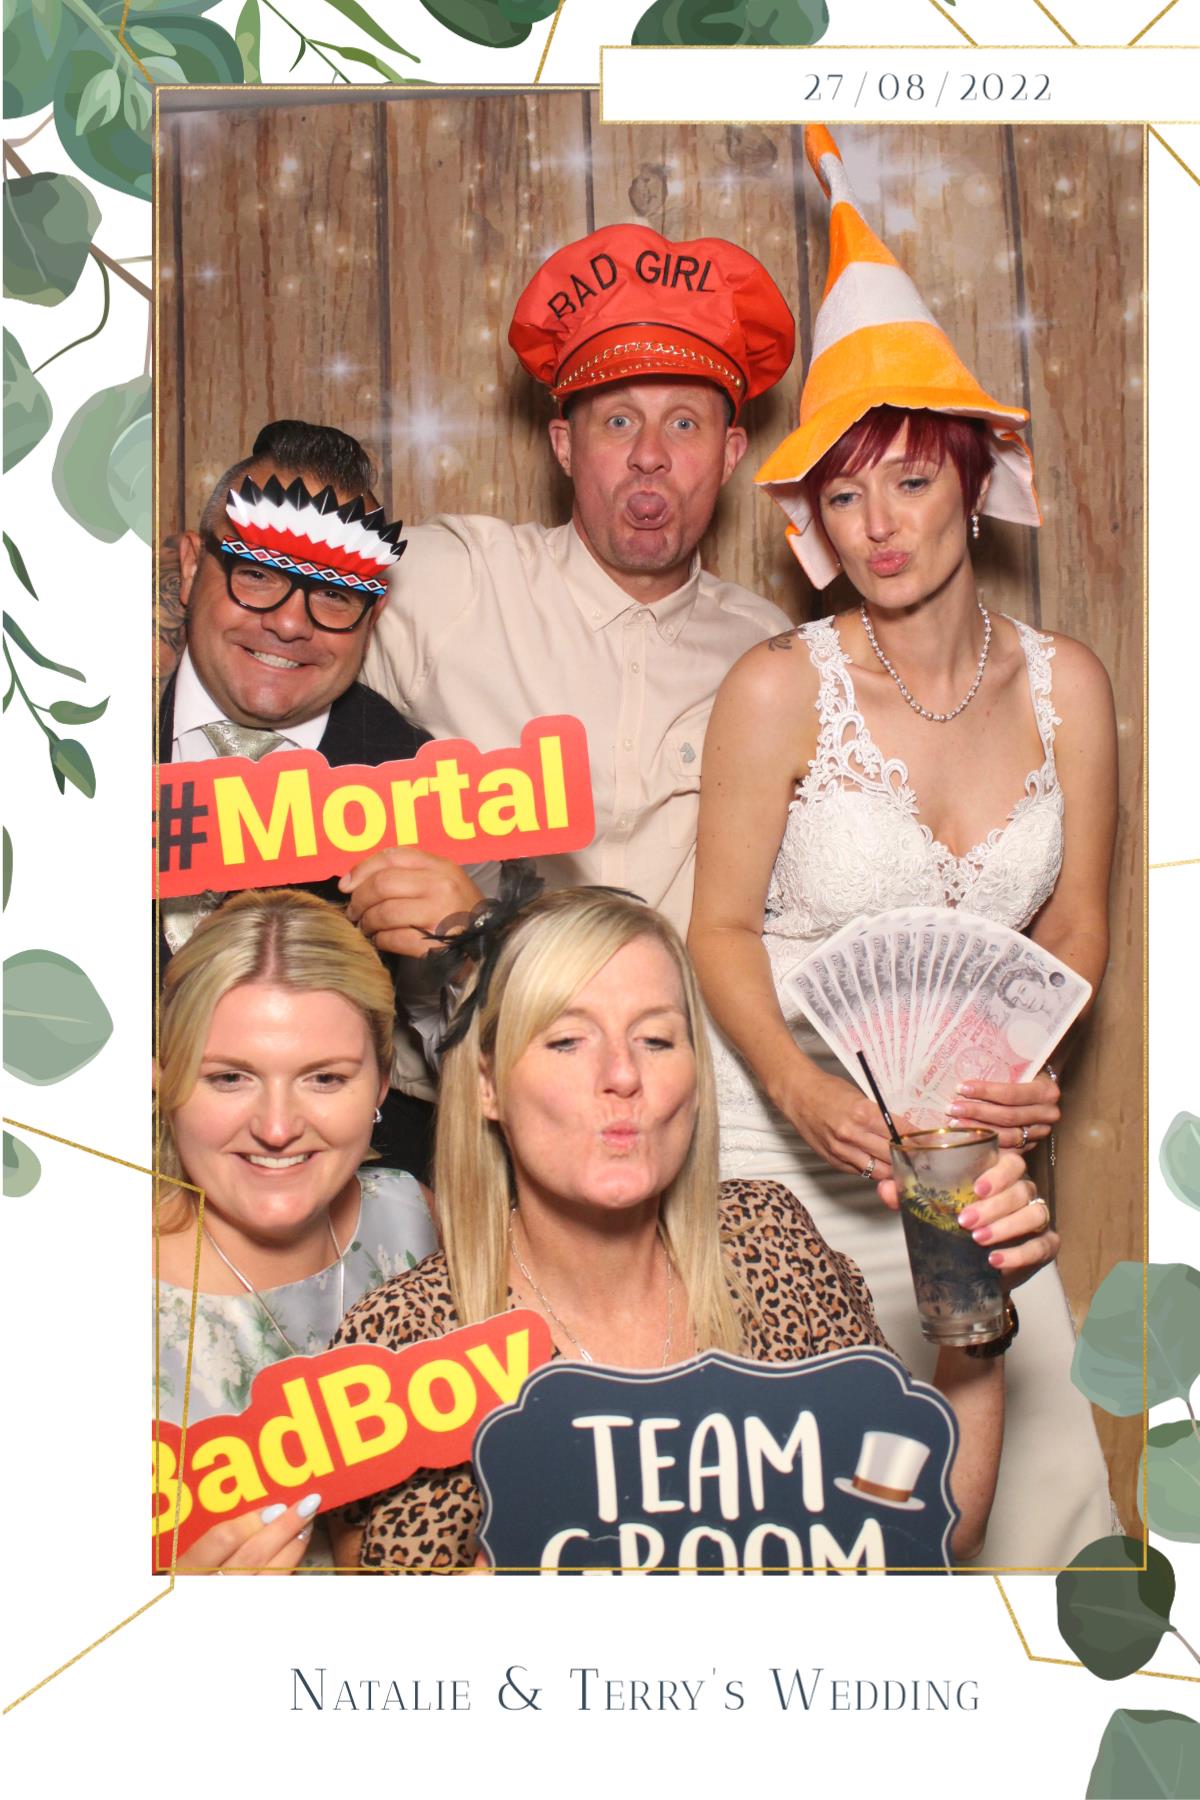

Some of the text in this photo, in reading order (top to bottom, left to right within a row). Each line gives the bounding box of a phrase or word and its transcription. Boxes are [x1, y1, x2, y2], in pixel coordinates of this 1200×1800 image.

[547, 250, 716, 320] BAD GIRL
[152, 736, 569, 873] #Mortal
[571, 1410, 825, 1523] TEAM
